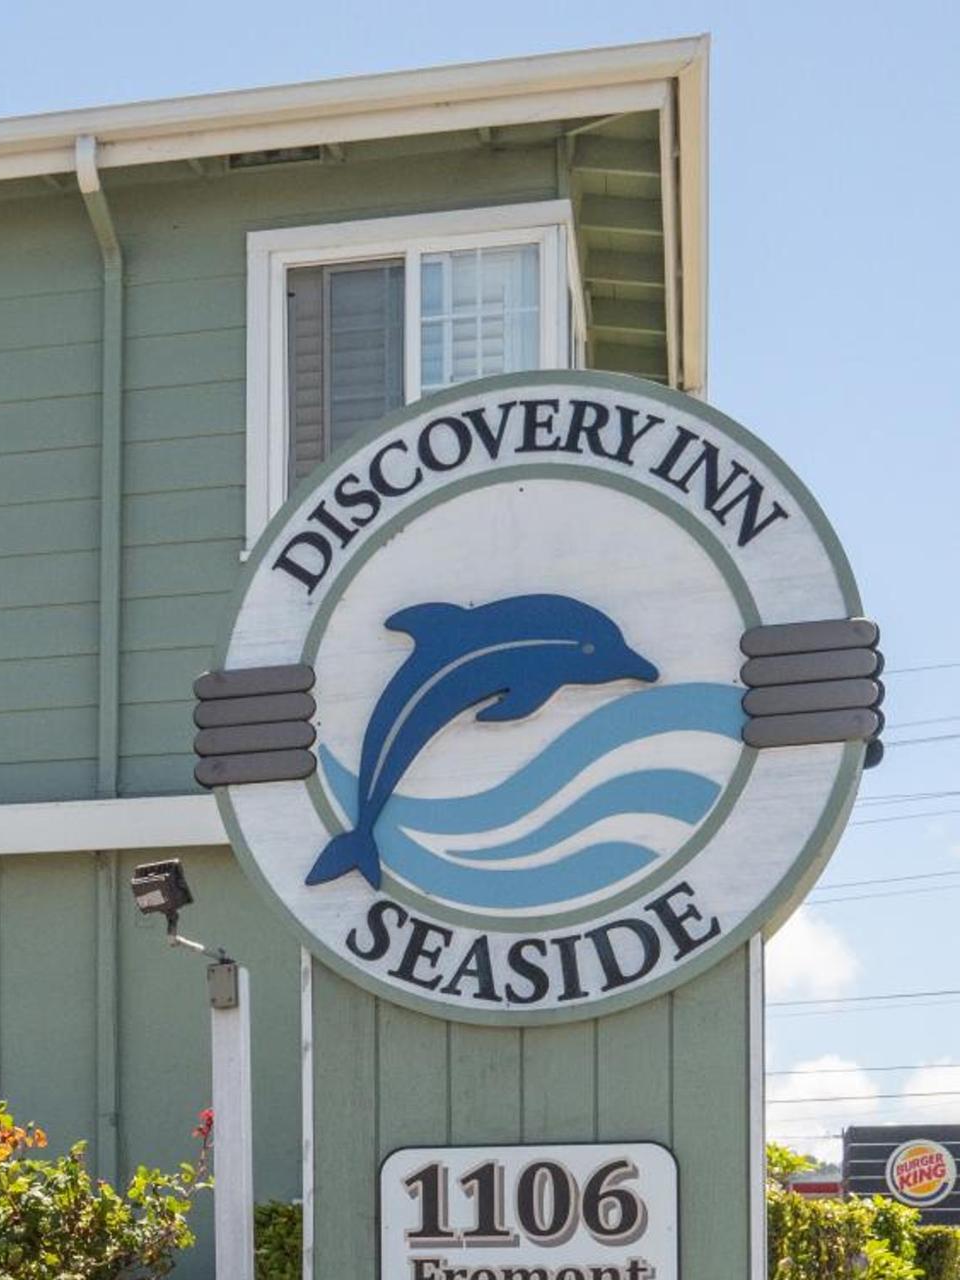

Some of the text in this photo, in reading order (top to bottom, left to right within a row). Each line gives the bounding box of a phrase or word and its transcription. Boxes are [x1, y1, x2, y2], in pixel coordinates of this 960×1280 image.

[272, 399, 789, 595] DISCOVERY INN
[347, 882, 721, 1004] SEASIDE
[401, 1159, 648, 1248] 1106
[896, 1153, 944, 1176] BURGER
[899, 1163, 946, 1190] KING
